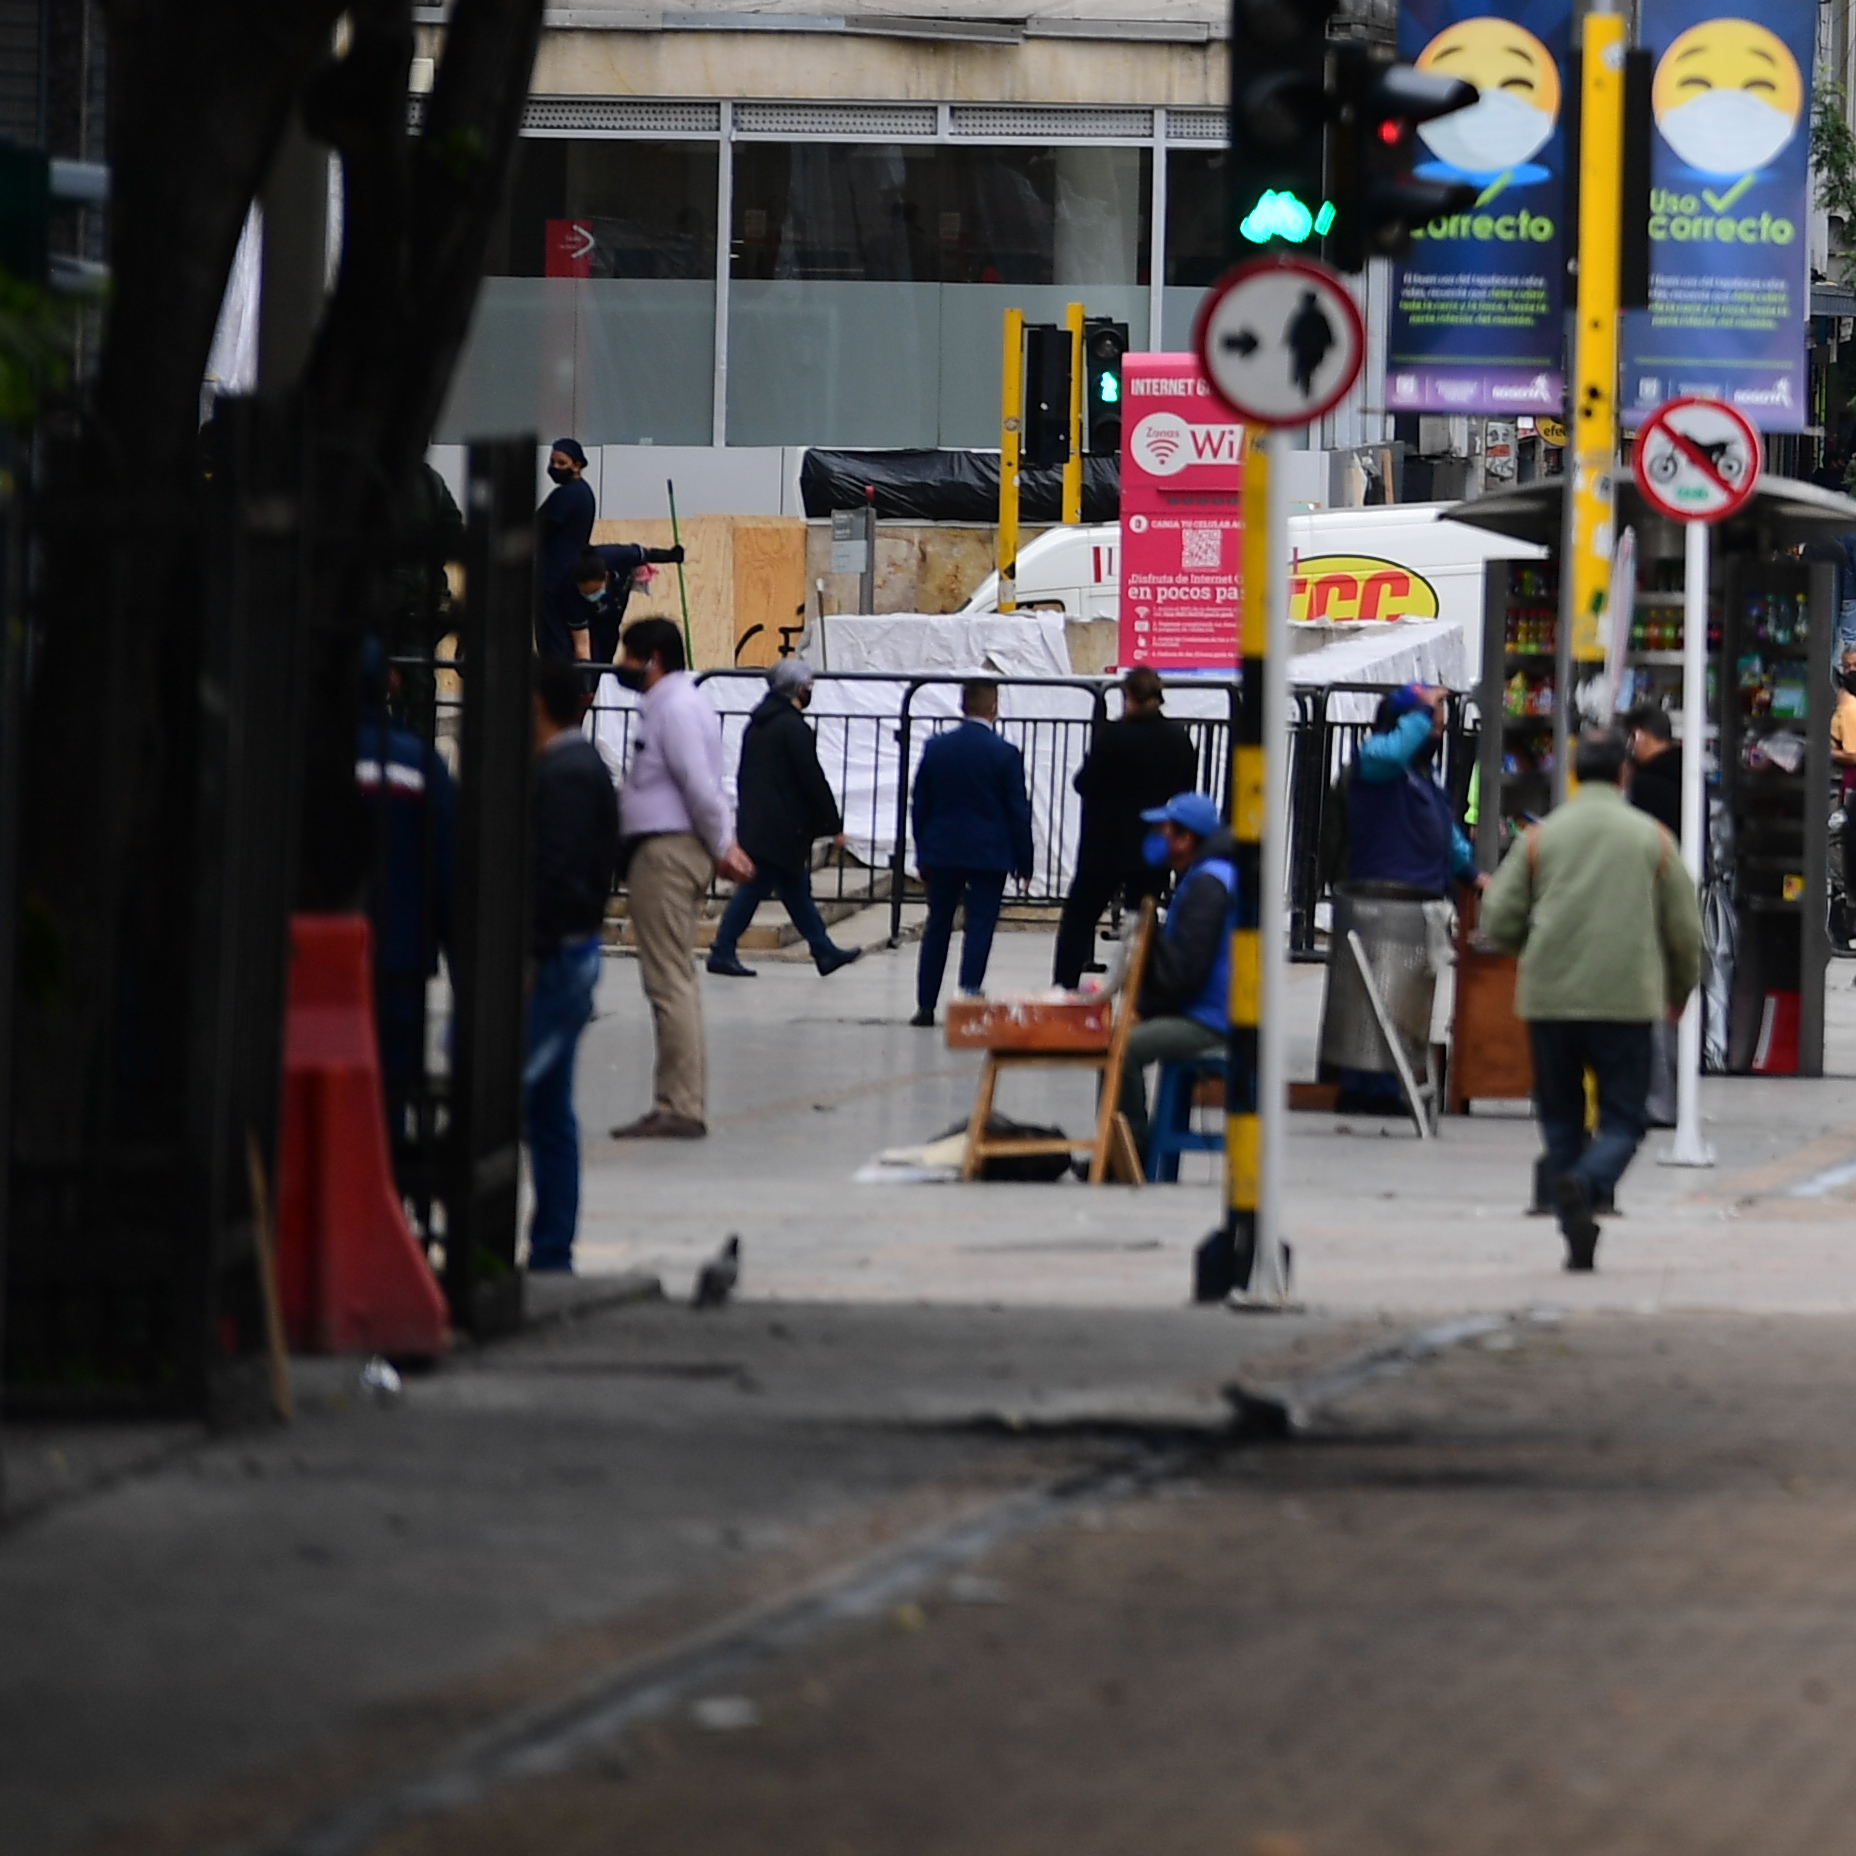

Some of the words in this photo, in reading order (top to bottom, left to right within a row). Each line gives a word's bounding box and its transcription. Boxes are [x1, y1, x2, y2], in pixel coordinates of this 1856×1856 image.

[1650, 189, 1697, 214] Uso
[1648, 211, 1794, 244] correcto
[1131, 378, 1195, 396] INTERNET
[1146, 427, 1179, 438] Zonas
[1175, 573, 1188, 584] de
[1190, 573, 1232, 584] Internet
[1128, 586, 1152, 600] en
[1156, 586, 1211, 604] pocos
